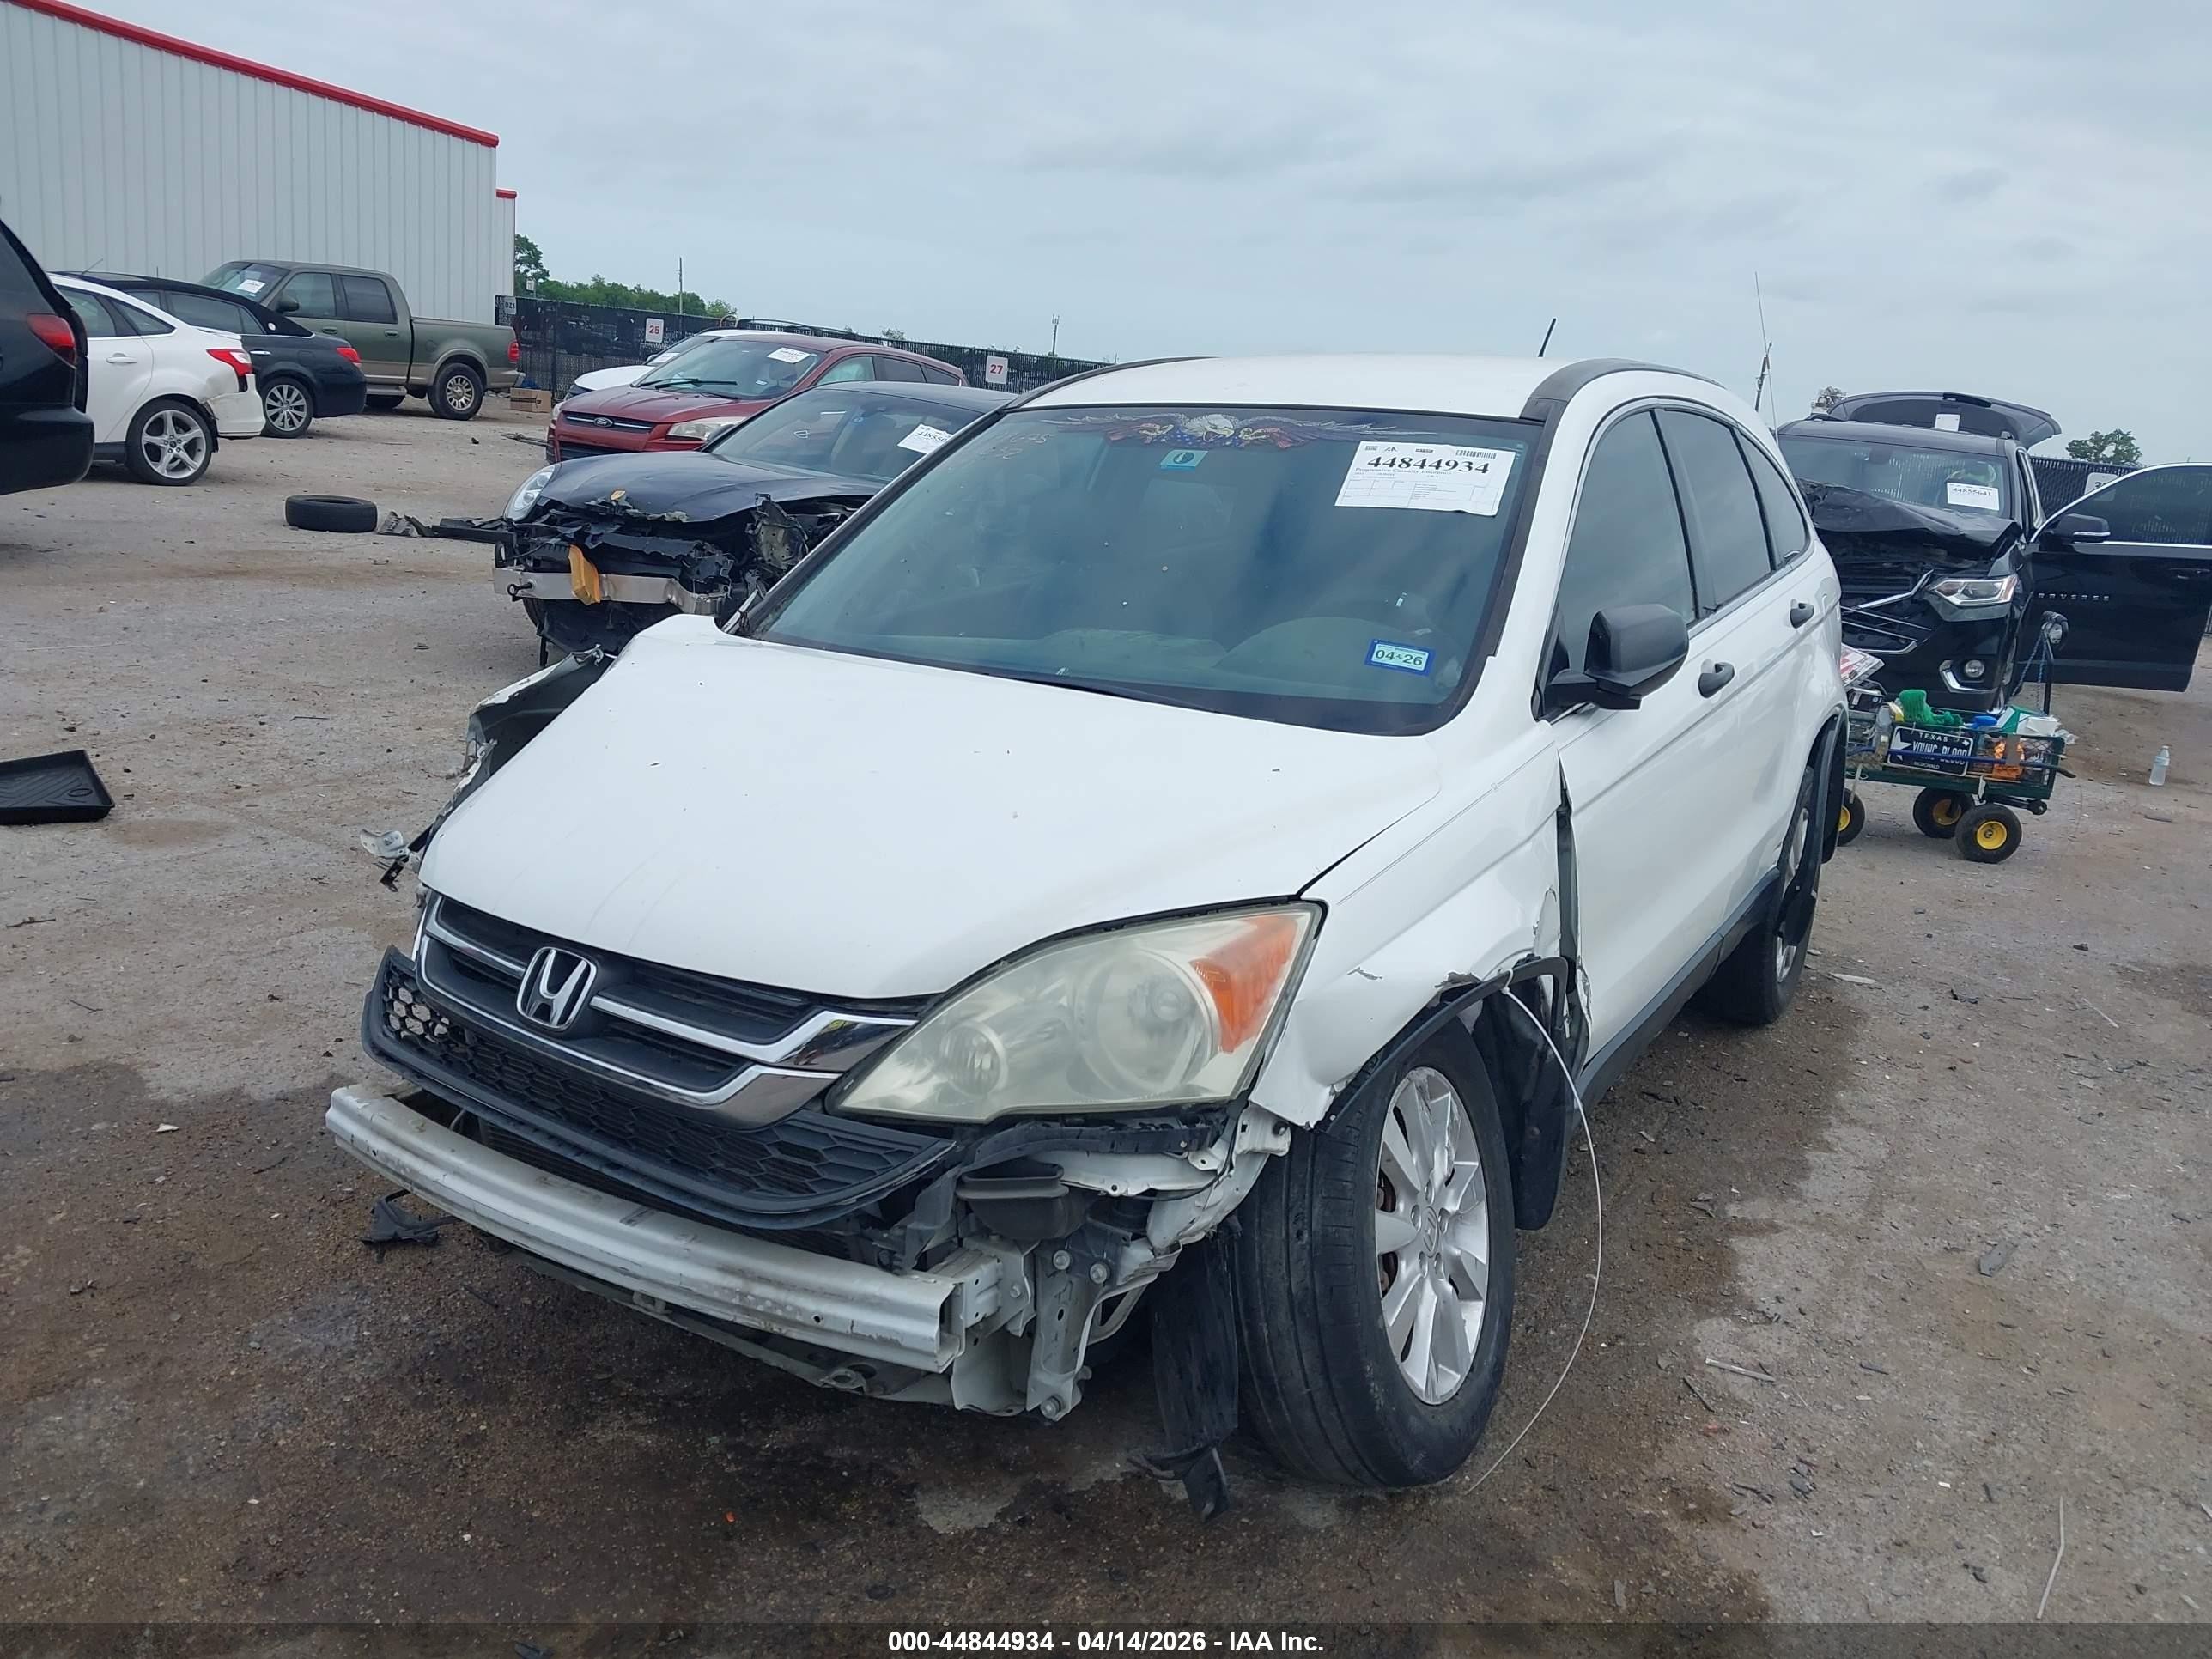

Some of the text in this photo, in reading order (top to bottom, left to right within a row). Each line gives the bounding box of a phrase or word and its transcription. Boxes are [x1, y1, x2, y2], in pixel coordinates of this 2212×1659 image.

[649, 325, 660, 335] 25
[990, 364, 1004, 374] 27
[1367, 456, 1490, 474] 44844934
[1919, 732, 1948, 742] TEXAS
